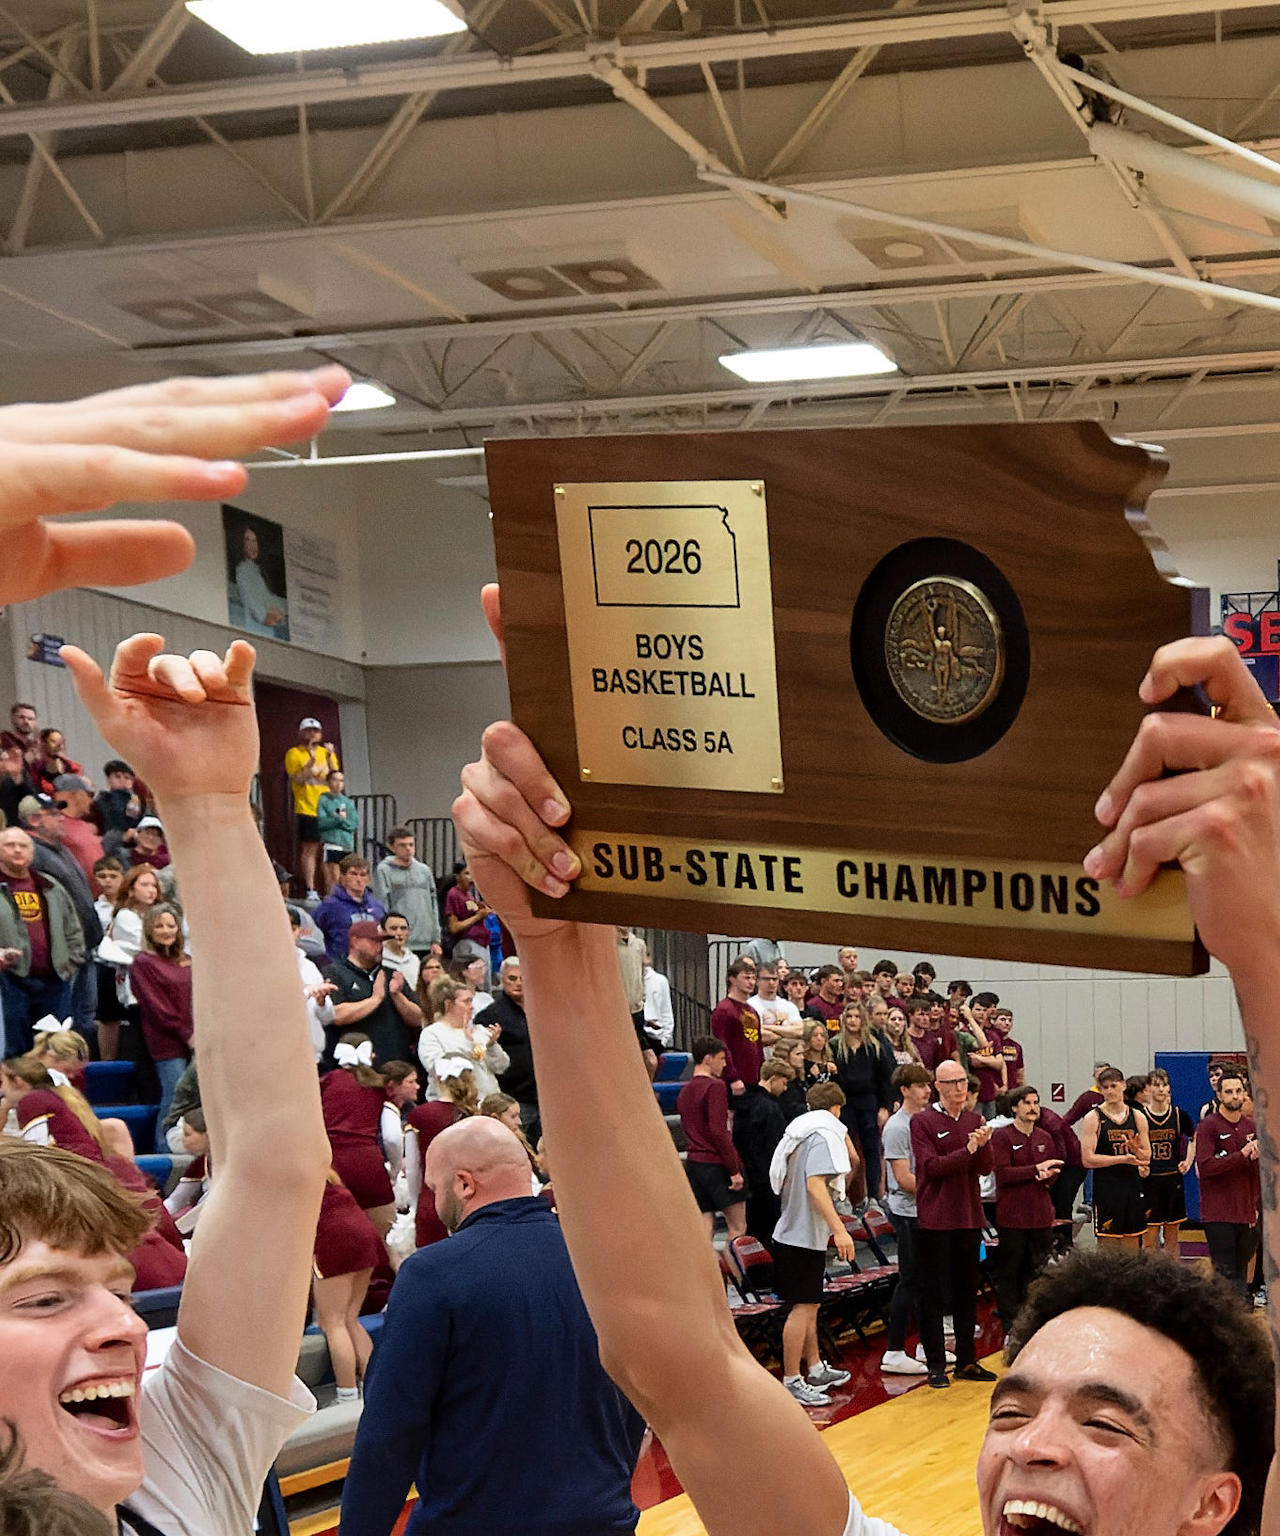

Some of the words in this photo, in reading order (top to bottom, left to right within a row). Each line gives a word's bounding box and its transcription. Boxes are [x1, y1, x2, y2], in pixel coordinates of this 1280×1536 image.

[625, 539, 702, 574] 2026
[635, 633, 704, 660] BOYS
[592, 668, 755, 698] BASKETBALL
[622, 726, 697, 752] CLASS
[704, 731, 734, 754] 5A
[593, 842, 803, 893] SUB-STATE
[836, 860, 1100, 917] CHAMPIONS
